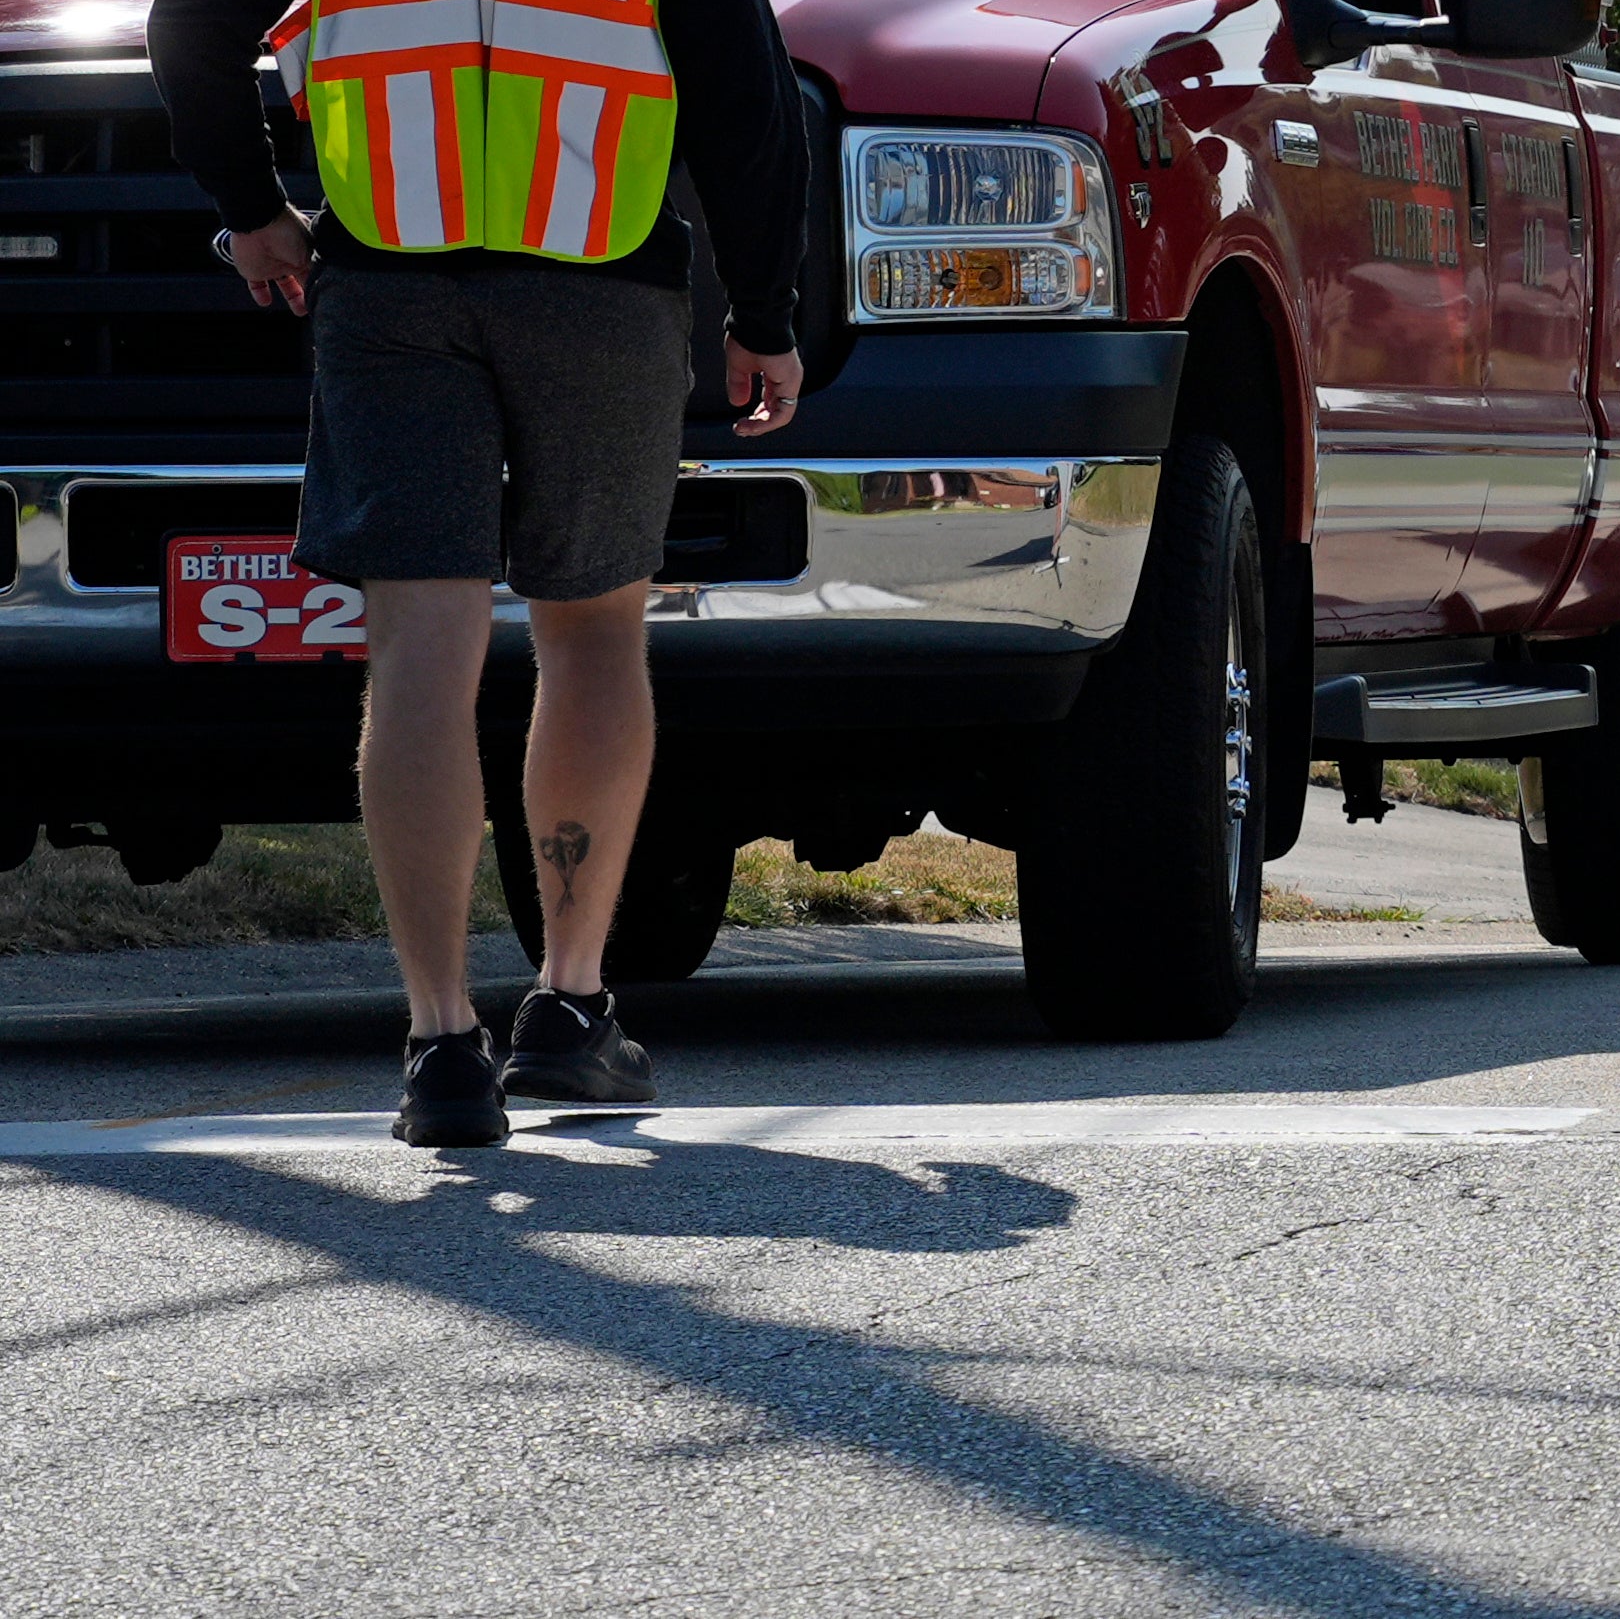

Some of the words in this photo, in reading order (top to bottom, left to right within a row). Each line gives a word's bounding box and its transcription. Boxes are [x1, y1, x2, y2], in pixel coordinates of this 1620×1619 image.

[1353, 110, 1420, 181] BETHEL
[1419, 122, 1462, 187] PARK
[1501, 132, 1560, 198] STATION
[1369, 197, 1403, 259] VOL.
[1404, 202, 1434, 263] FIRE
[1523, 218, 1545, 288] 110
[180, 553, 297, 581] BETHEL
[197, 583, 369, 648] S-2
